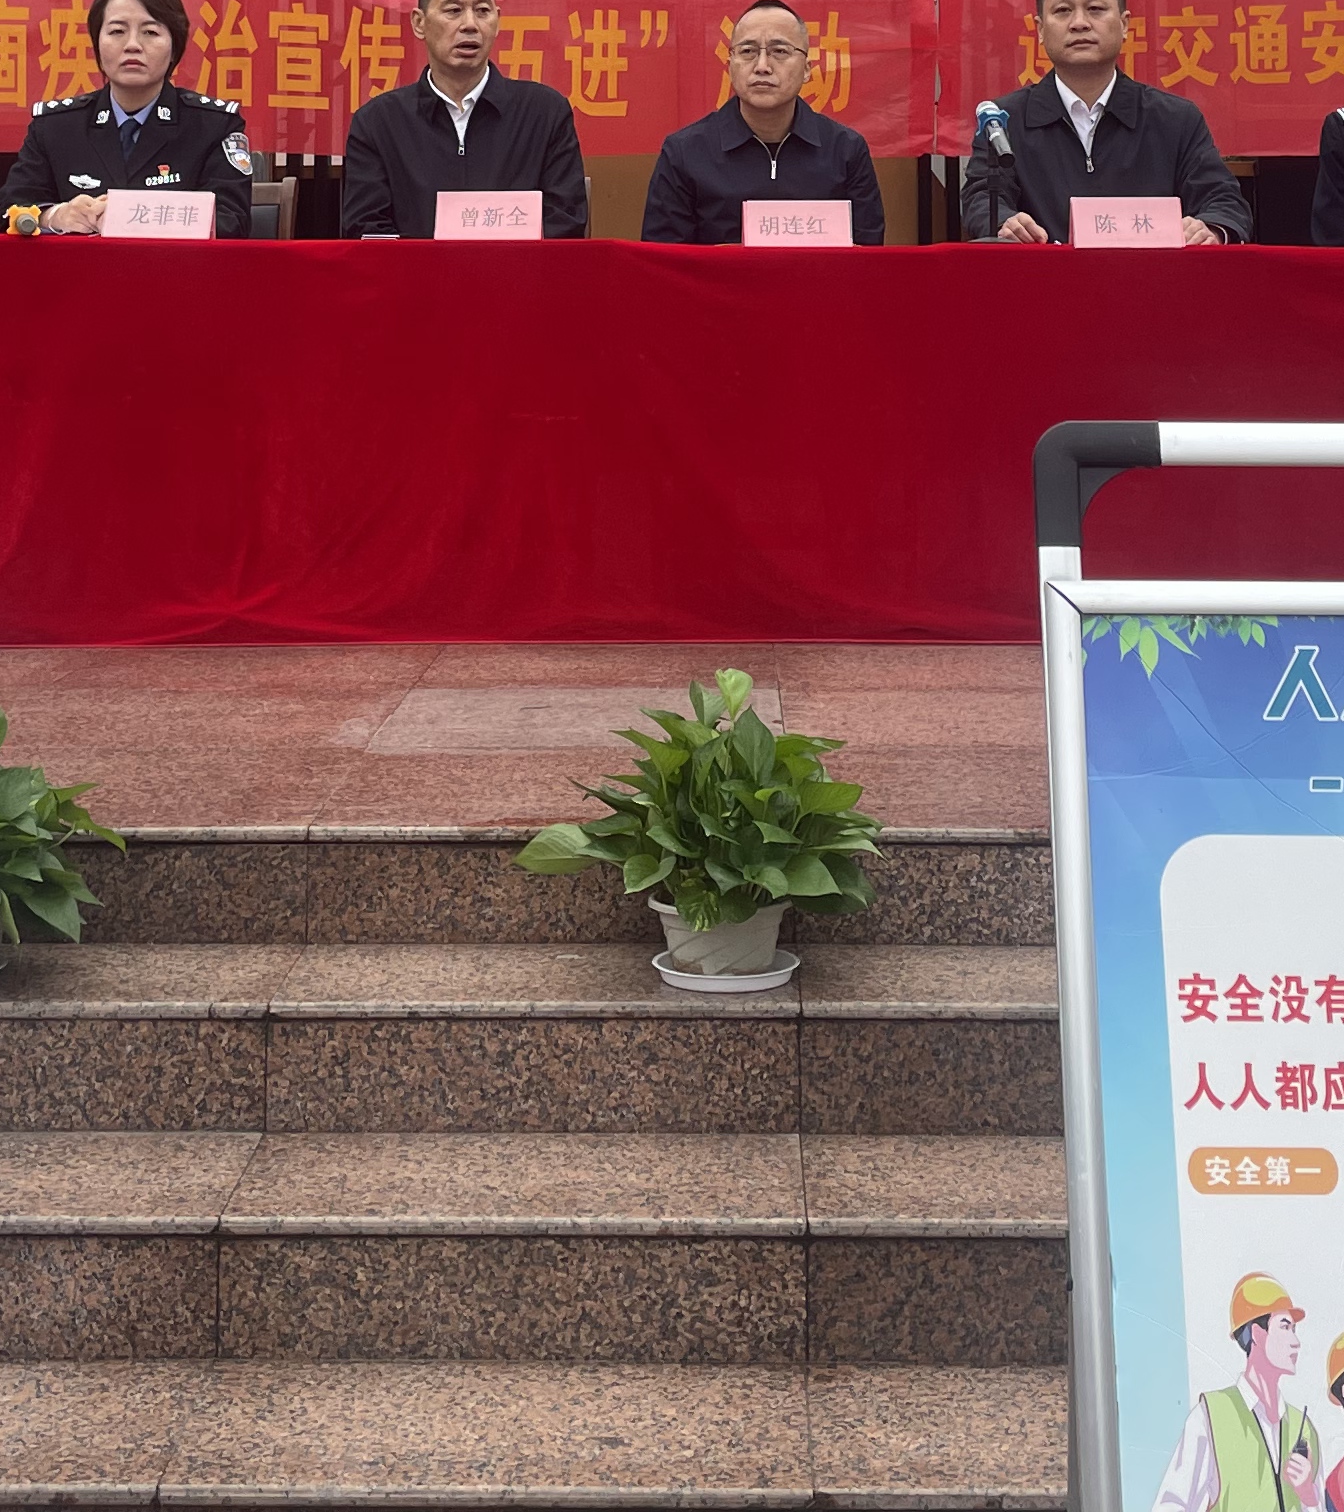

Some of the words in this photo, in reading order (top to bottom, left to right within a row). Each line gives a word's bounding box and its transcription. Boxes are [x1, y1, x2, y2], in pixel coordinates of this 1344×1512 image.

[127, 203, 199, 227] 龙菲菲
[460, 205, 529, 228] 曾新全
[758, 215, 829, 236] 胡连红
[1094, 212, 1155, 234] 陈林
[1204, 1157, 1322, 1187] 安全第一
